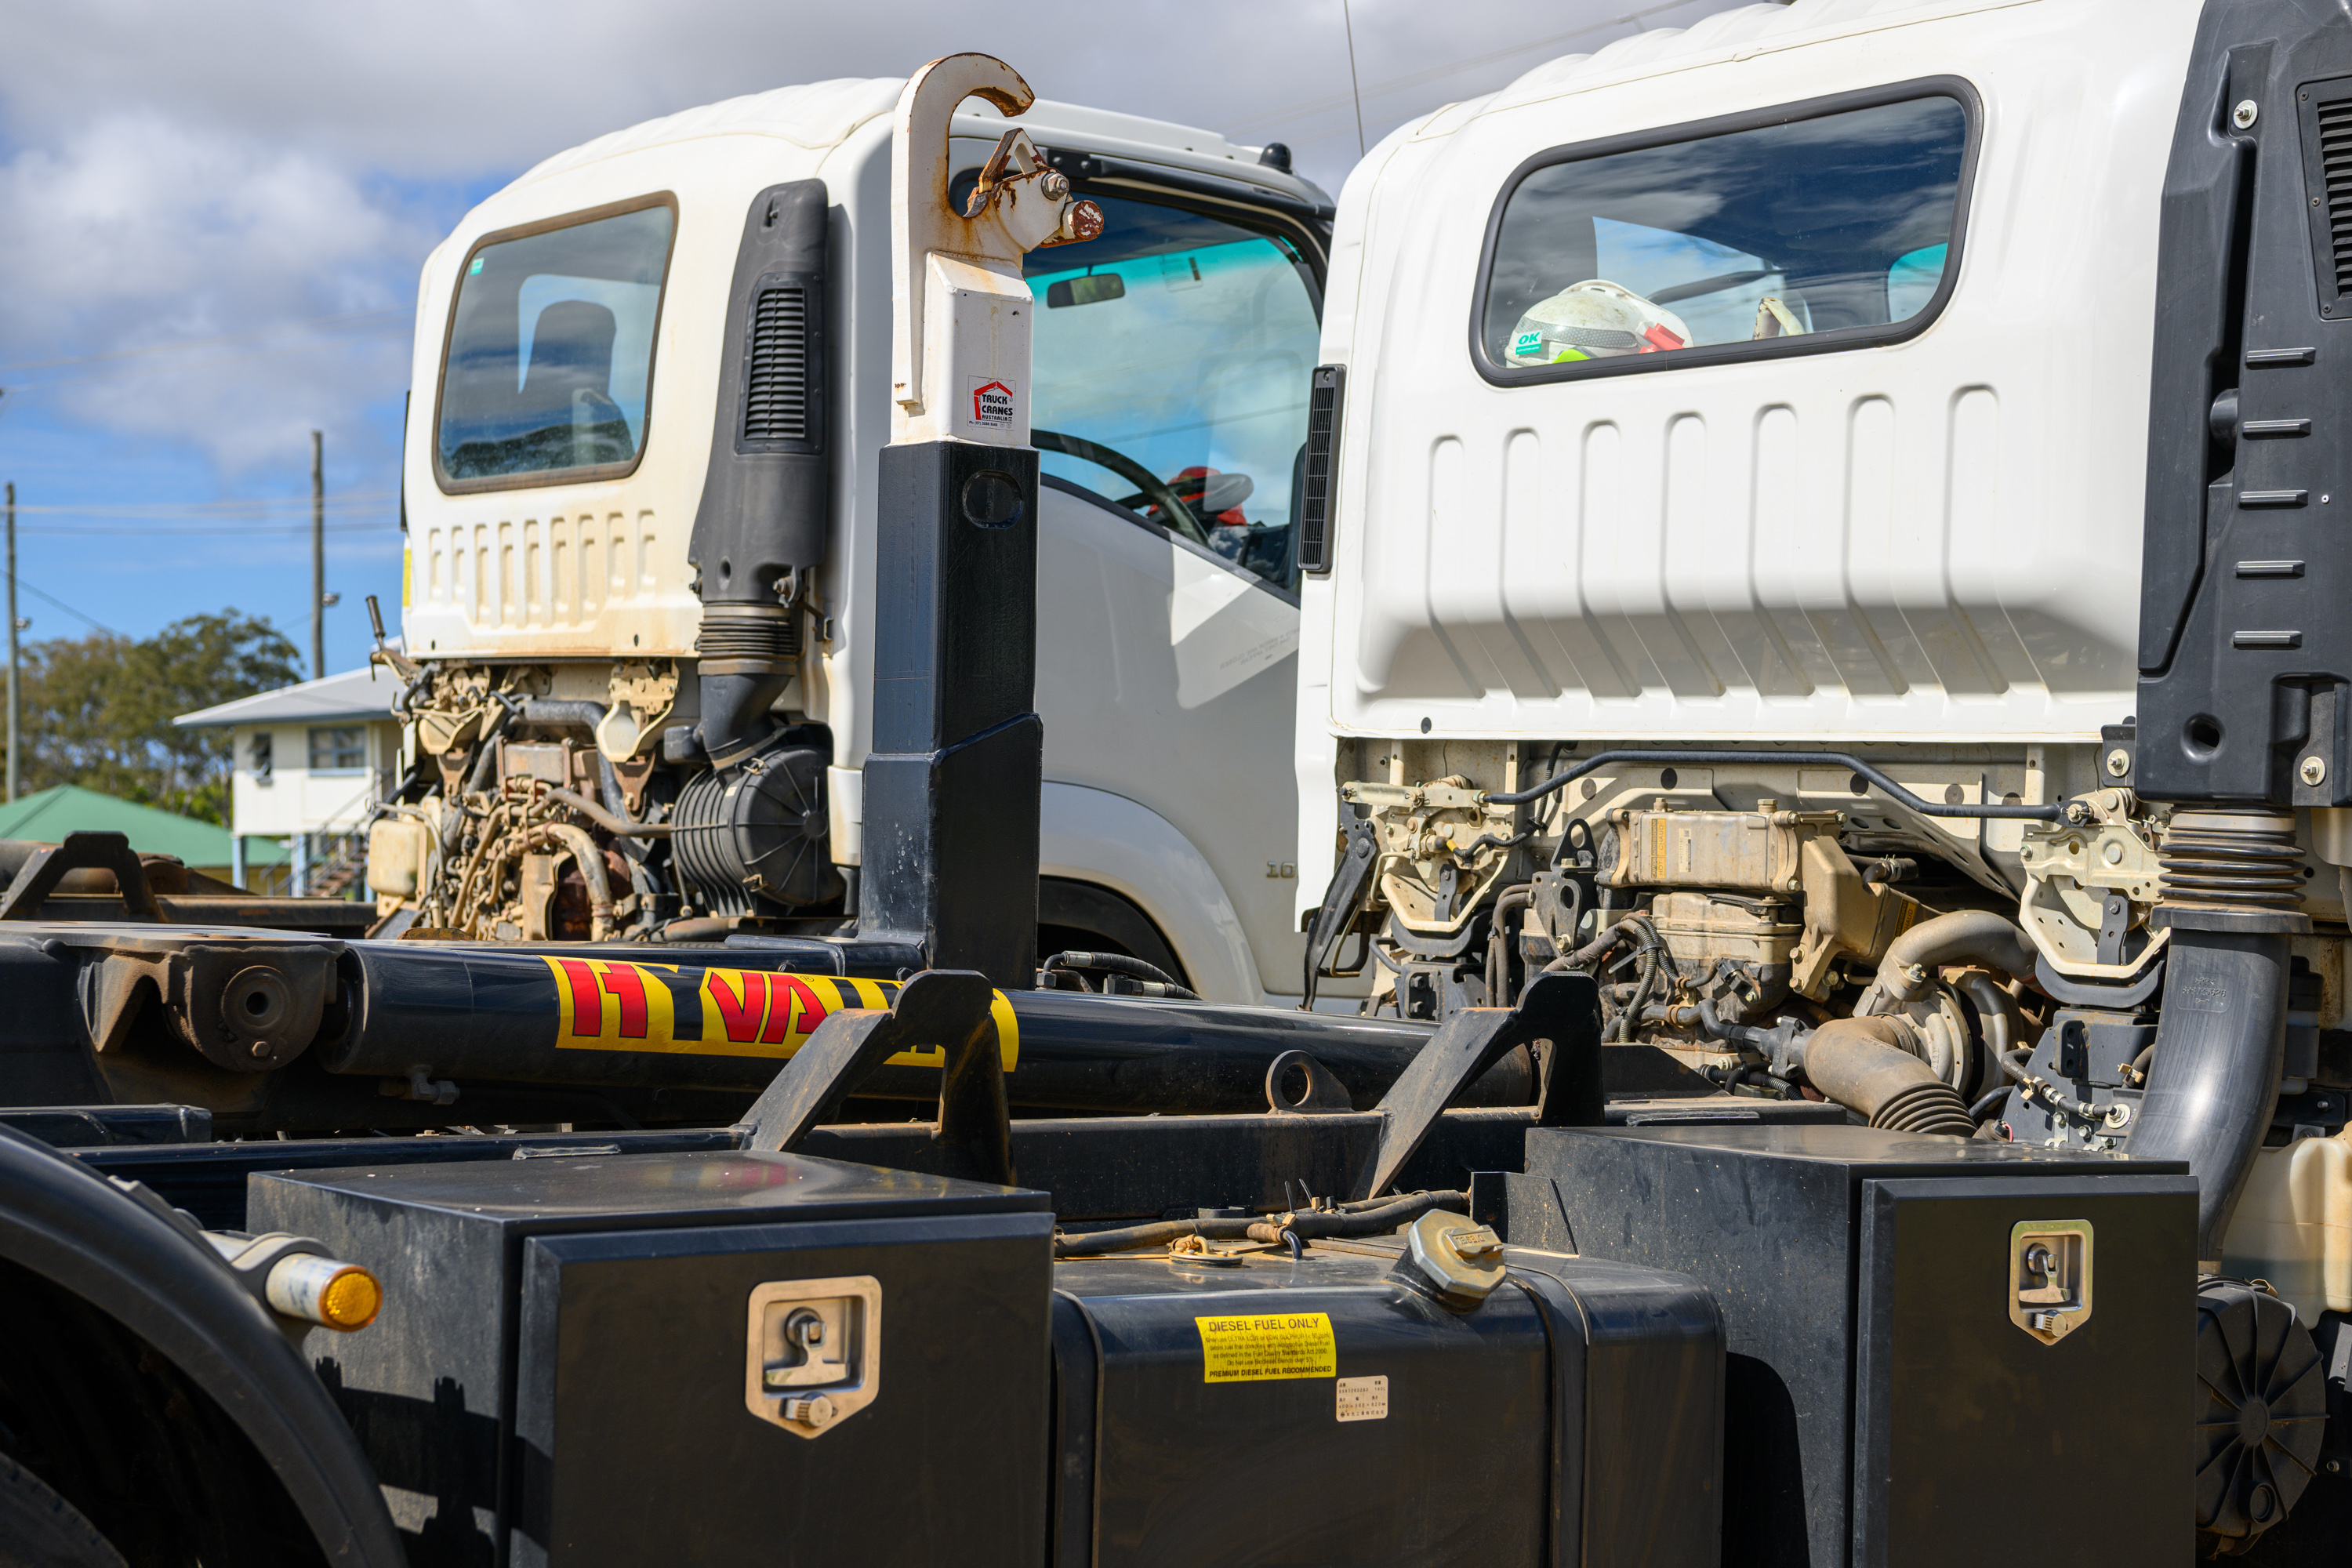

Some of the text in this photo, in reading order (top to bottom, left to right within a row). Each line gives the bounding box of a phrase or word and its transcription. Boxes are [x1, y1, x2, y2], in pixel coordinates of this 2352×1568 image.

[1518, 332, 1540, 345] OK
[982, 394, 1007, 405] TRUCK
[982, 405, 1013, 416] CRANES
[1455, 1234, 1485, 1245] DIESEL
[1209, 1318, 1319, 1332] DIESEL FUEL ONLY
[1282, 1366, 1332, 1374] RECOMMENDED
